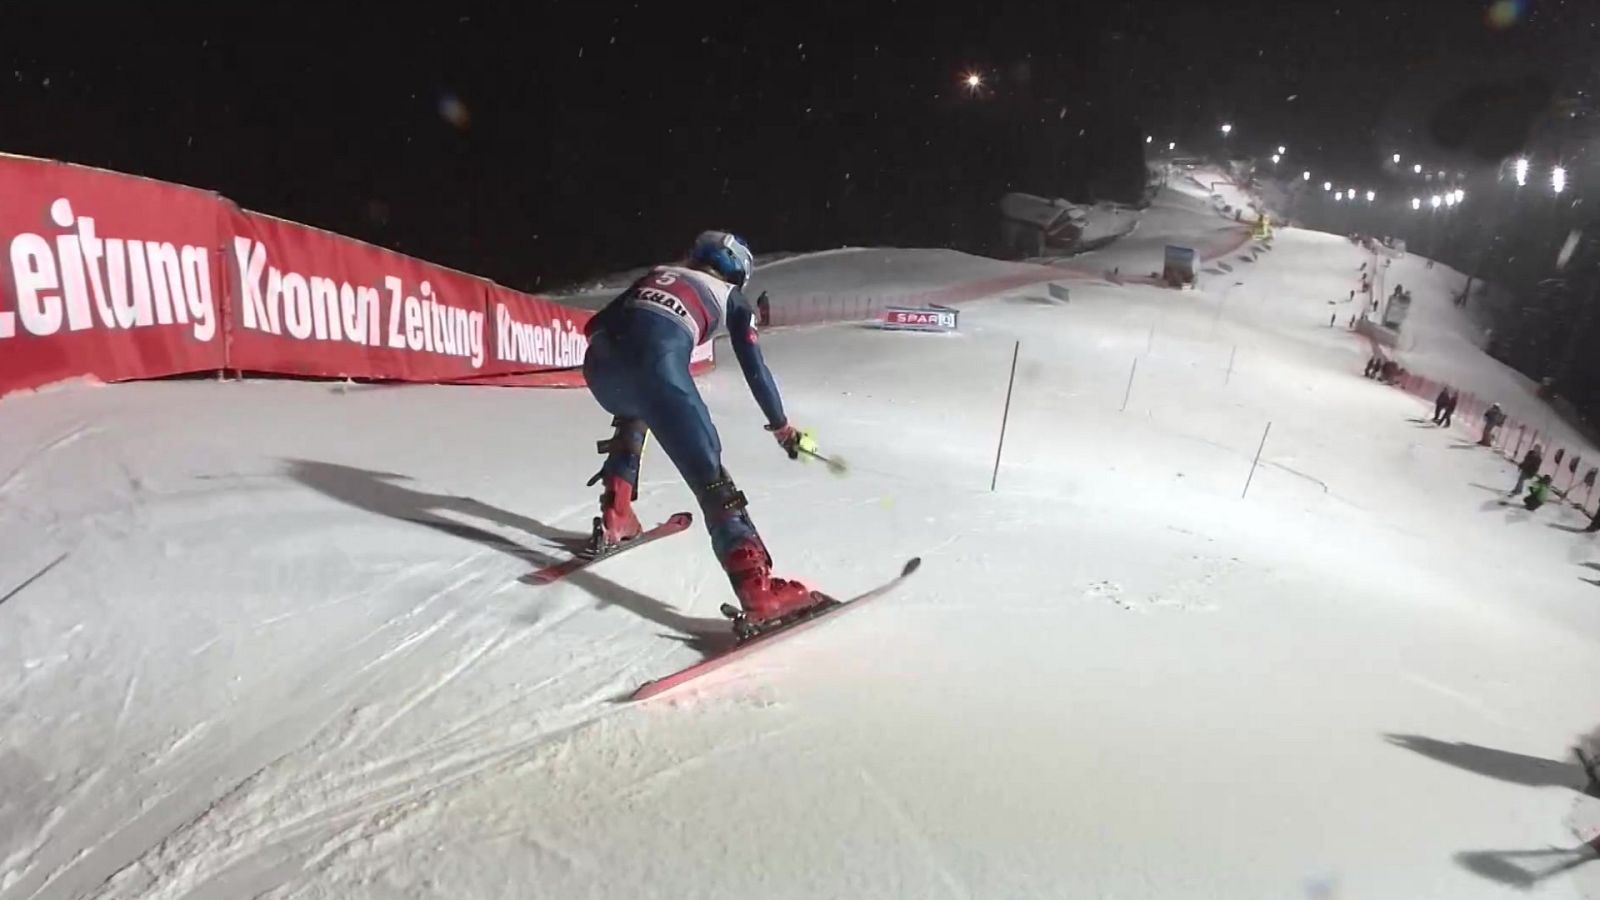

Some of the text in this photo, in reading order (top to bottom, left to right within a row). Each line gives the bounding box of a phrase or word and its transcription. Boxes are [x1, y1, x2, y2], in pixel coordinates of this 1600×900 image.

[0, 198, 216, 342] eitung
[234, 236, 484, 369] Kronen Zeitung
[897, 313, 937, 324] SPAR
[496, 303, 553, 365] Kronen
